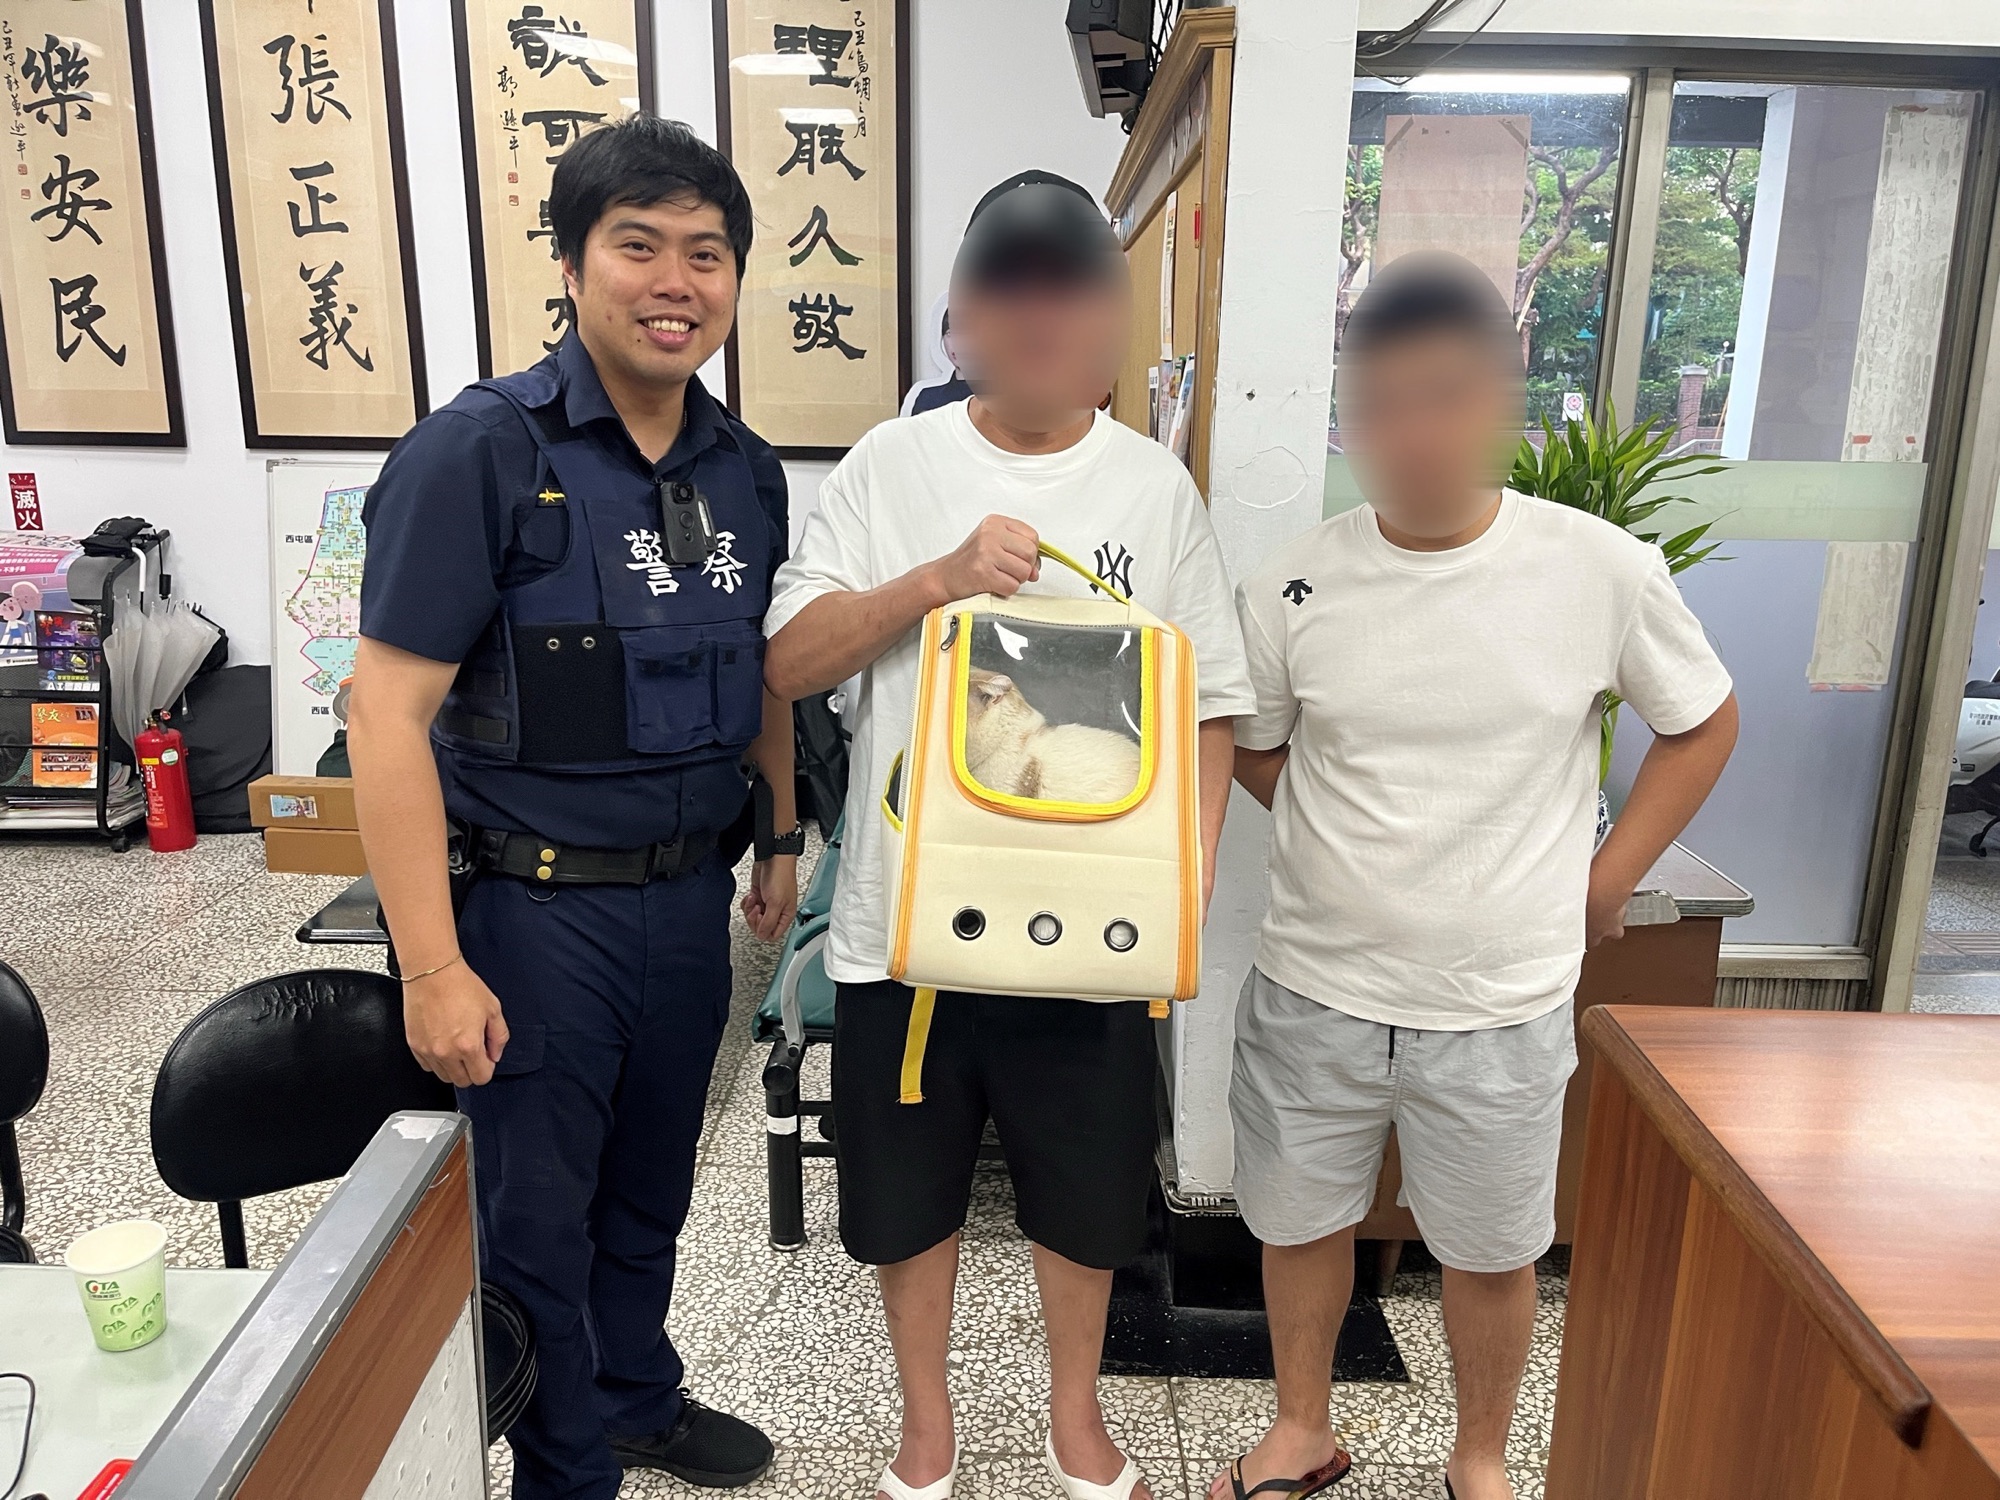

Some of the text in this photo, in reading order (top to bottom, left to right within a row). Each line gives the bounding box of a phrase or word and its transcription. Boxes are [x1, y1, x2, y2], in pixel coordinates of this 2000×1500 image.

[21, 34, 126, 367] 樂安民
[263, 0, 374, 372] 張正義
[14, 490, 40, 529] 滅火
[285, 534, 314, 544] 西屯區
[623, 528, 748, 597] 警察
[1089, 541, 1134, 598] NY
[311, 706, 329, 715] 西區
